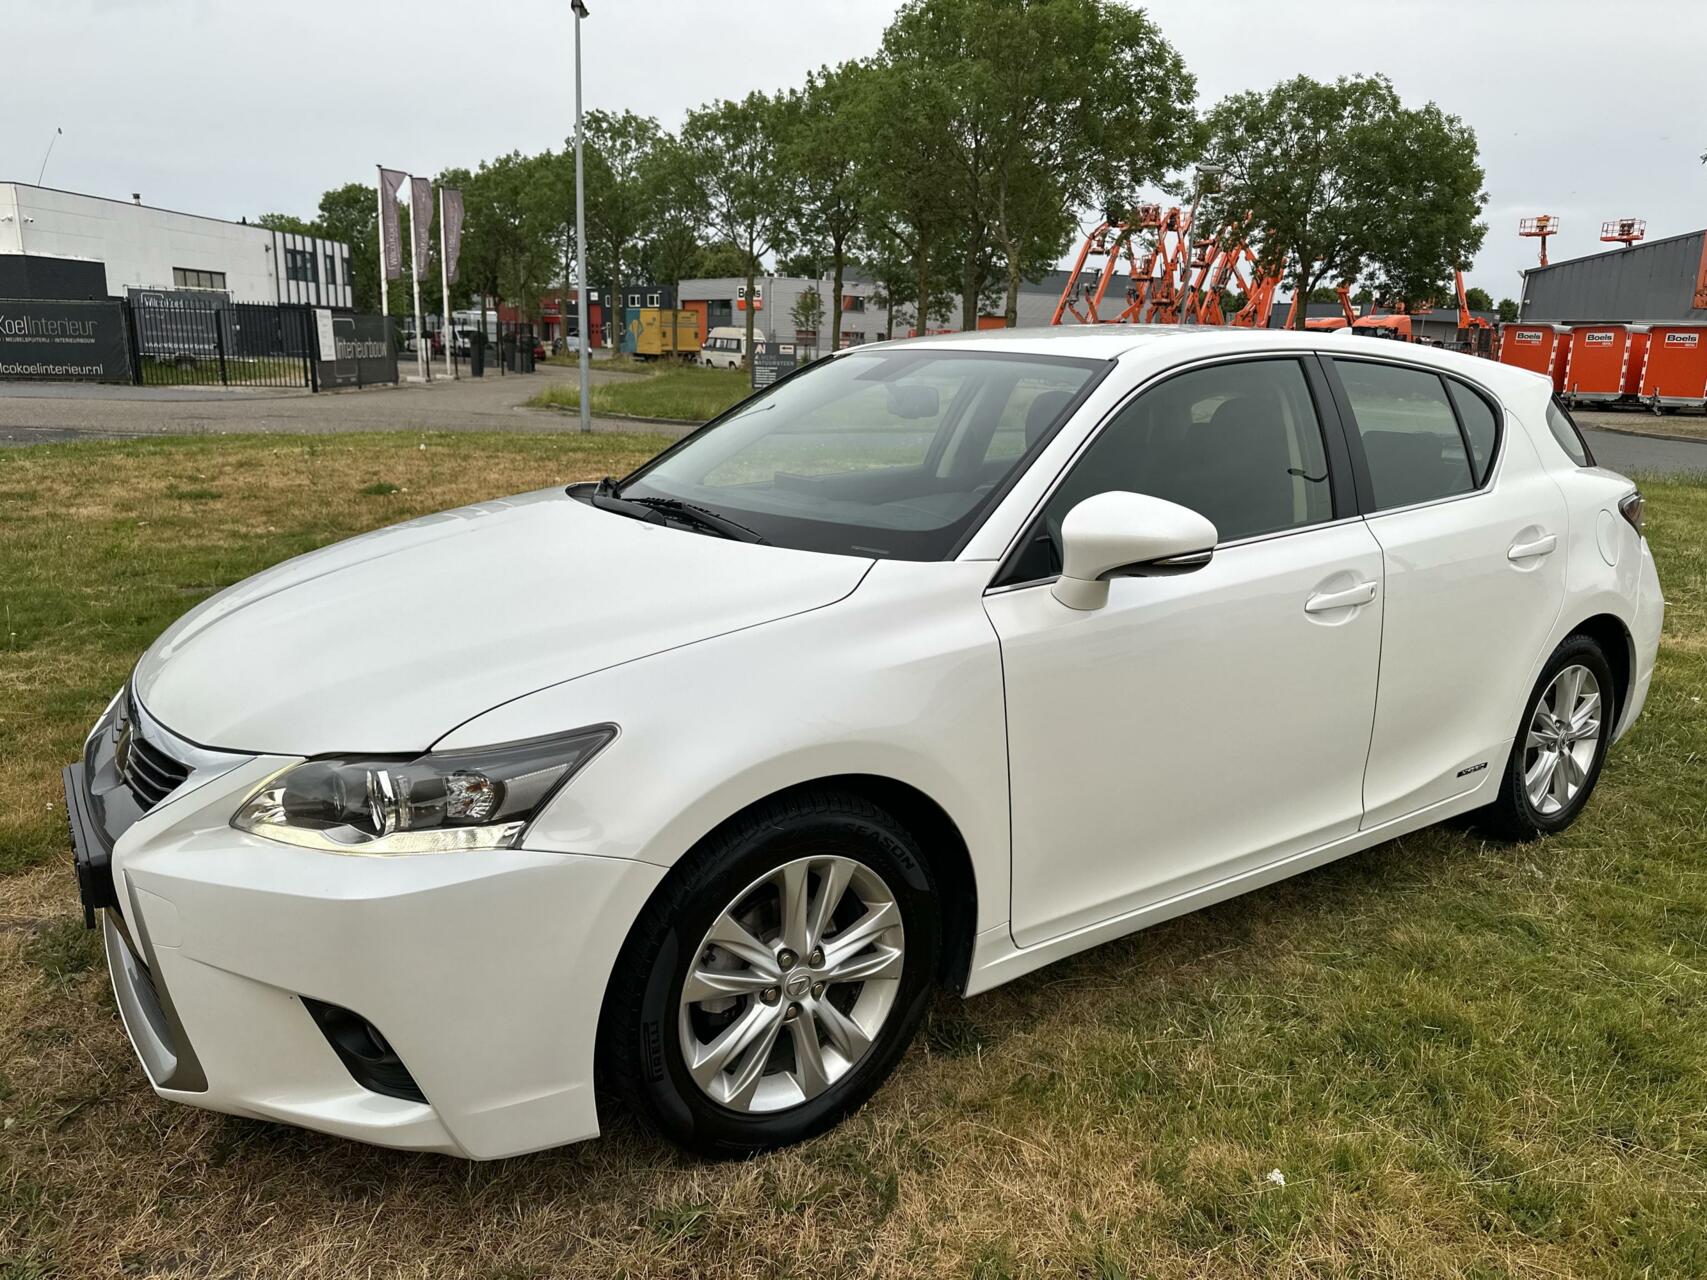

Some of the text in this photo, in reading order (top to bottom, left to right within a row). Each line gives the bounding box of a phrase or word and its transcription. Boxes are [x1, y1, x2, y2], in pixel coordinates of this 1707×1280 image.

[1517, 332, 1541, 340] Boels
[1667, 334, 1697, 342] Boels
[335, 336, 387, 360] Interieurbouw
[642, 1020, 665, 1083] PIRELLI
